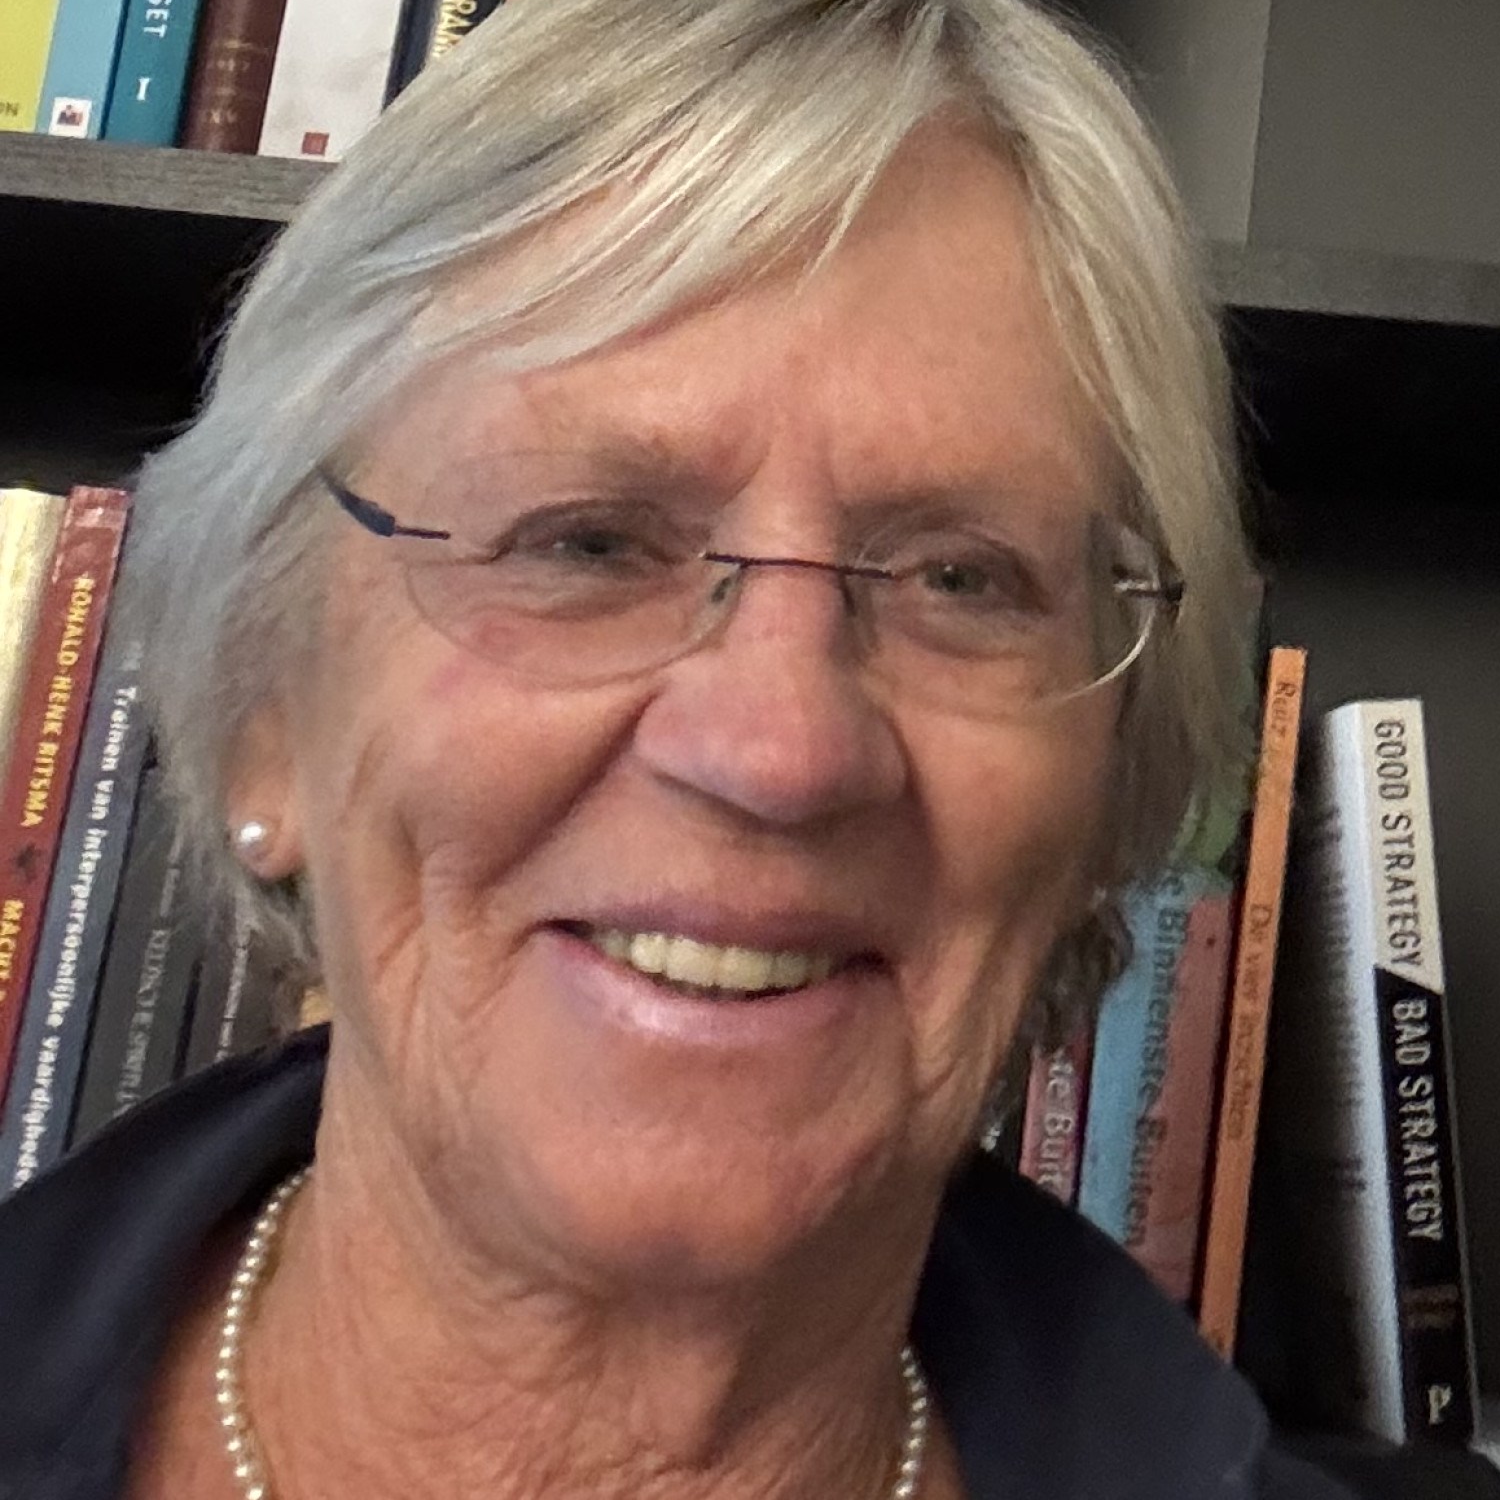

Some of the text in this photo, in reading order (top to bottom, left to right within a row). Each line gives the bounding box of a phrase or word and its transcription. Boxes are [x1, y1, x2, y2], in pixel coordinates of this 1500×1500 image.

[17, 737, 61, 830] RITSMA
[86, 775, 115, 822] van
[1368, 717, 1434, 971] GOOD STRATEGY
[41, 824, 110, 1028] interpersoonlijke
[5, 1031, 67, 1191] vaardighede
[1387, 995, 1453, 1245] BAD STRATEGY
